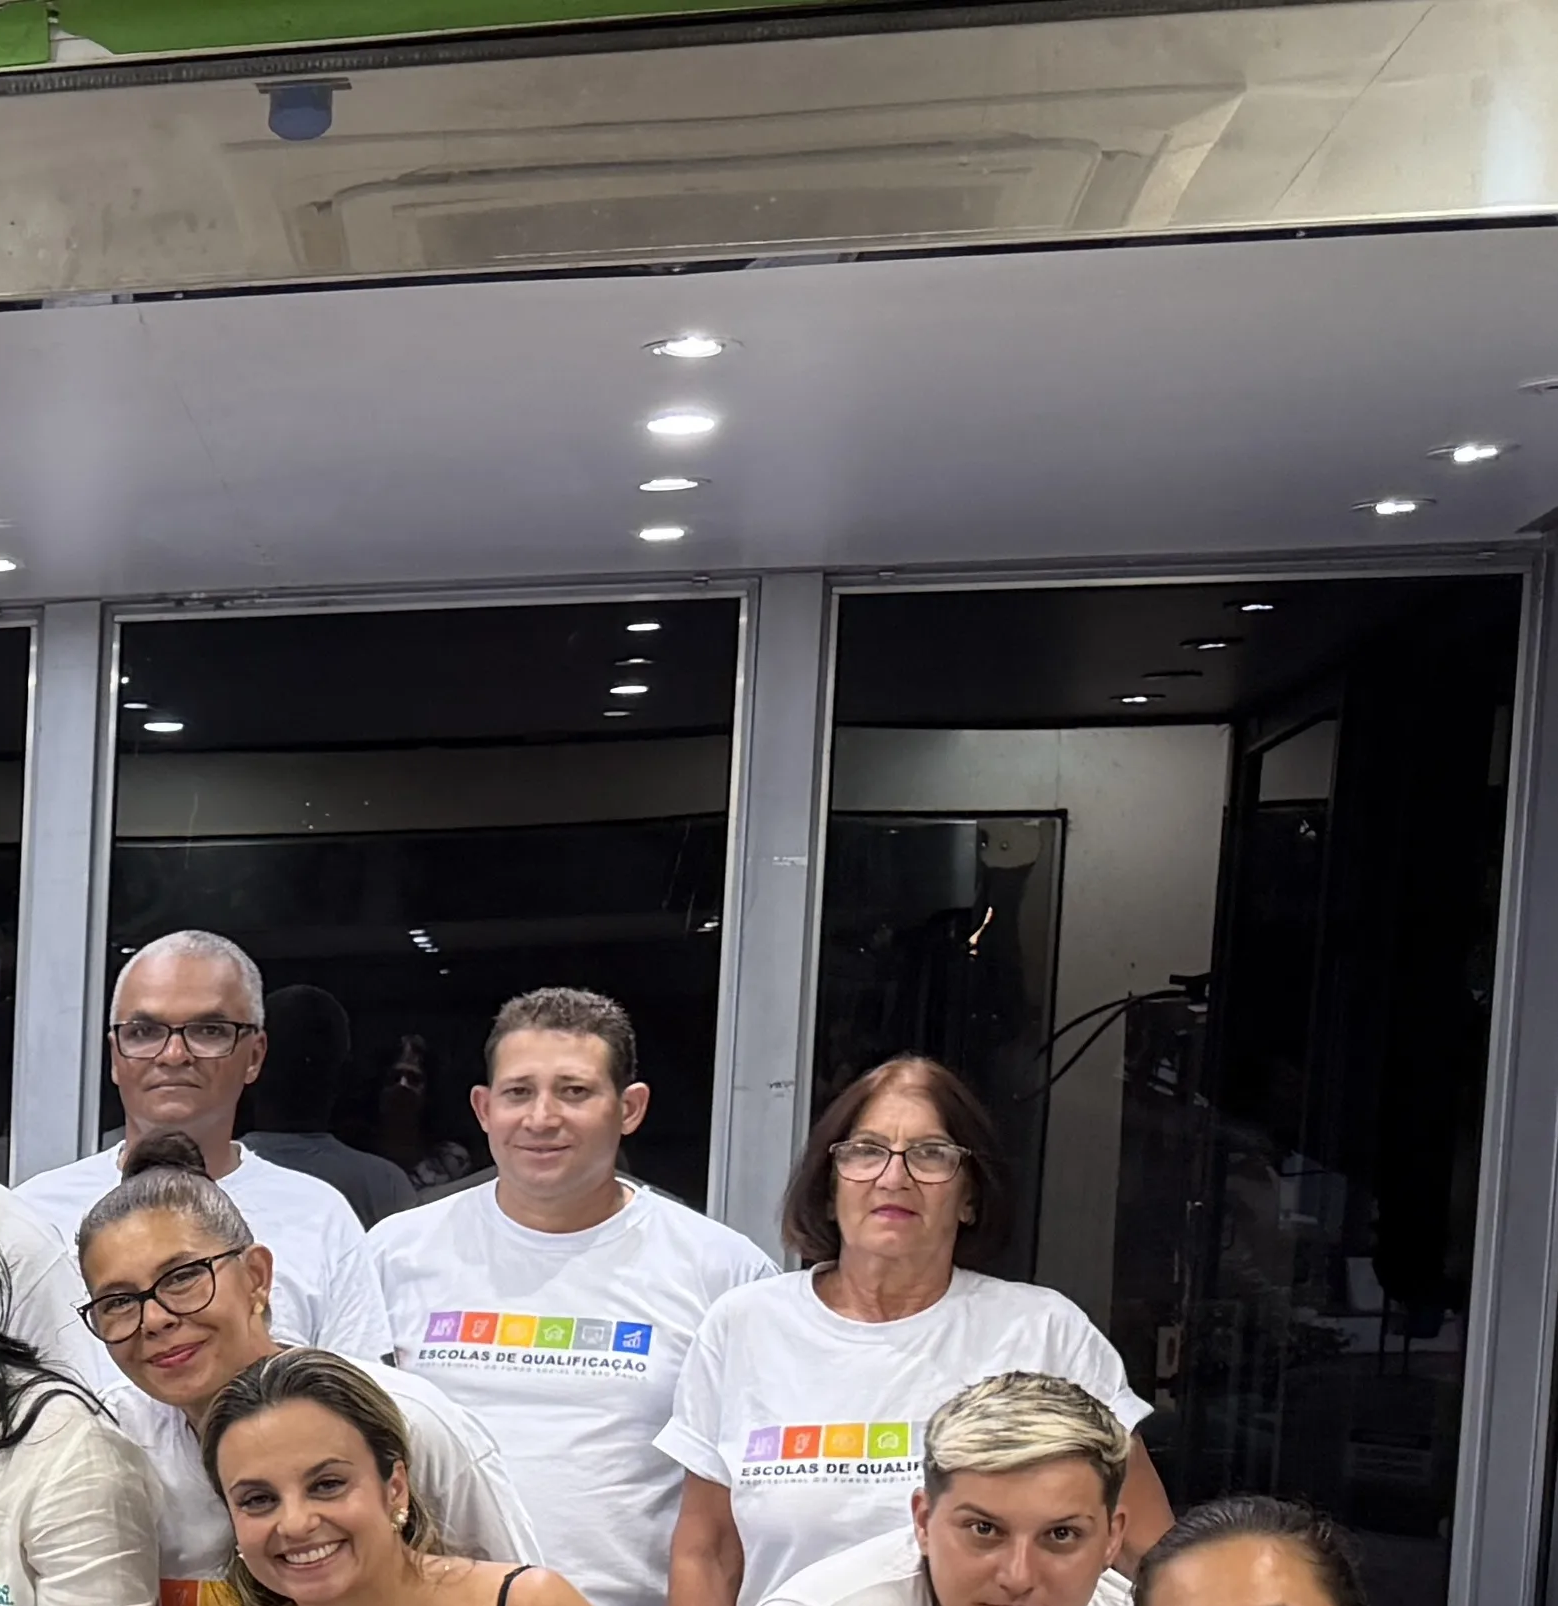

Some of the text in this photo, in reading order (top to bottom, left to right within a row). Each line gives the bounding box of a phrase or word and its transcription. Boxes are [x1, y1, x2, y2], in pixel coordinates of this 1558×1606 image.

[419, 1349, 647, 1372] ESCOLAS DE QUALIFICAÇÃO
[741, 1463, 819, 1477] ESCOLAS
[826, 1462, 850, 1475] DE
